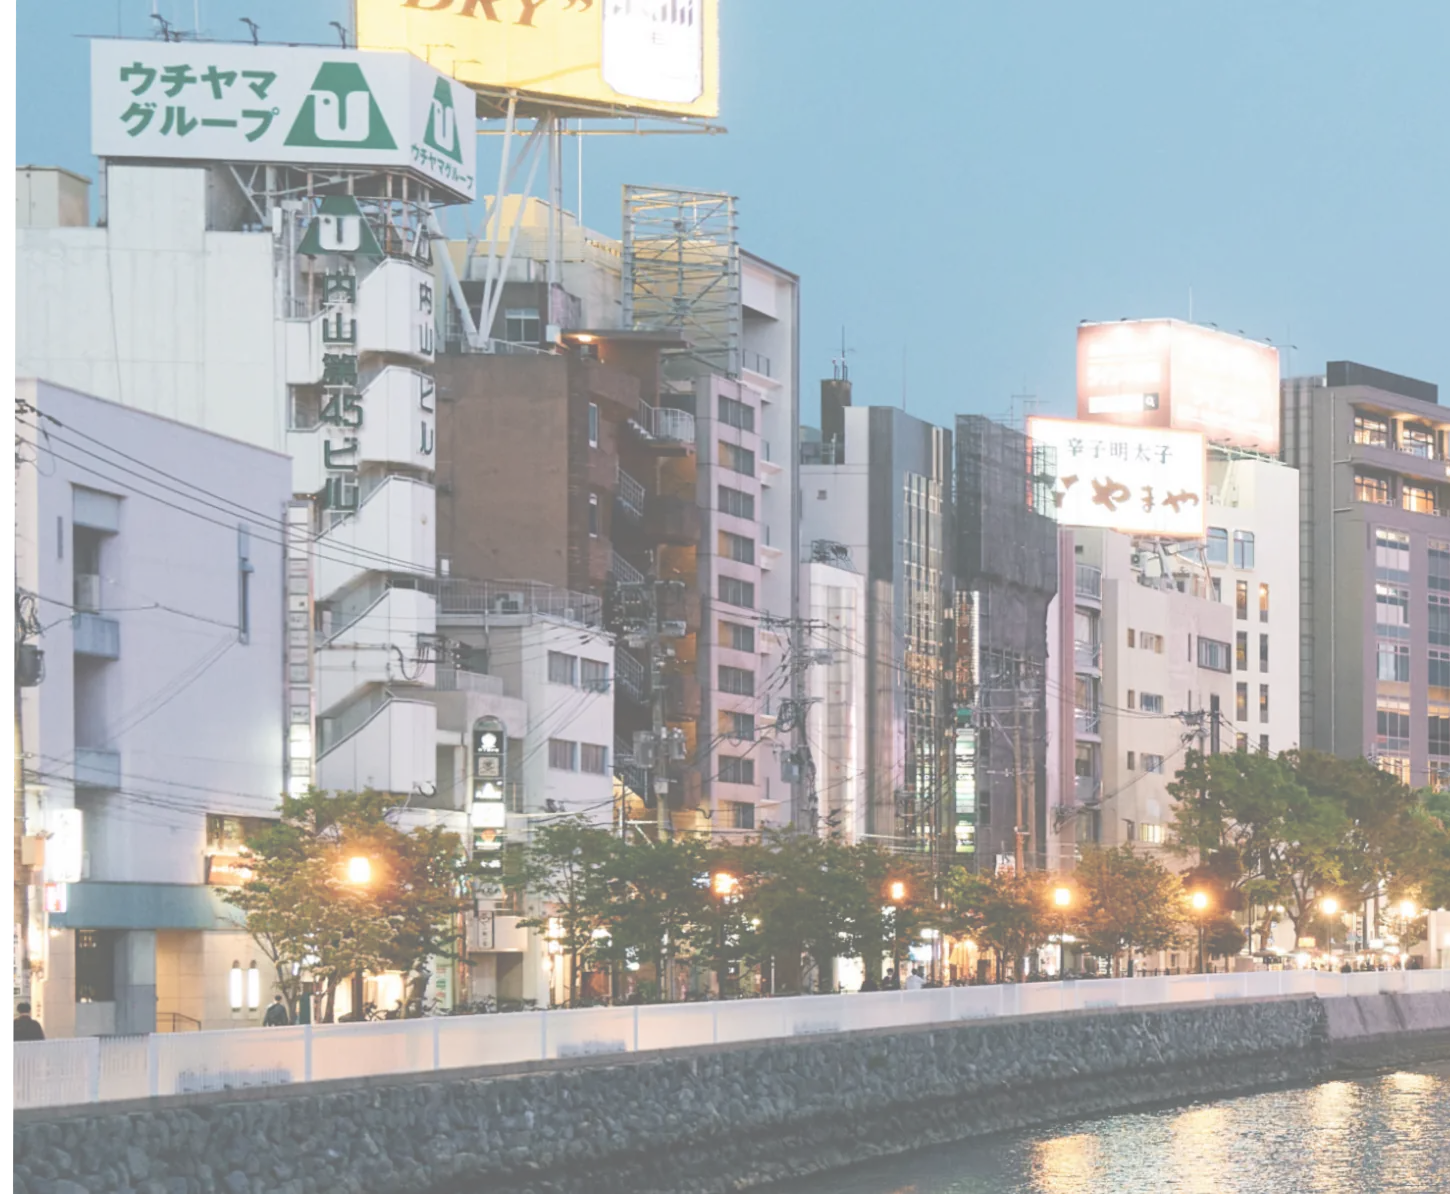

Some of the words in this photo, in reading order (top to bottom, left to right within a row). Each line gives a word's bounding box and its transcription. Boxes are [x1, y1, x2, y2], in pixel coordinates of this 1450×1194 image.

[119, 61, 278, 101] ウチヤマ
[119, 102, 280, 143] グループ
[411, 143, 474, 192] ウチヤマグループ
[1066, 436, 1174, 465] 辛子明太子
